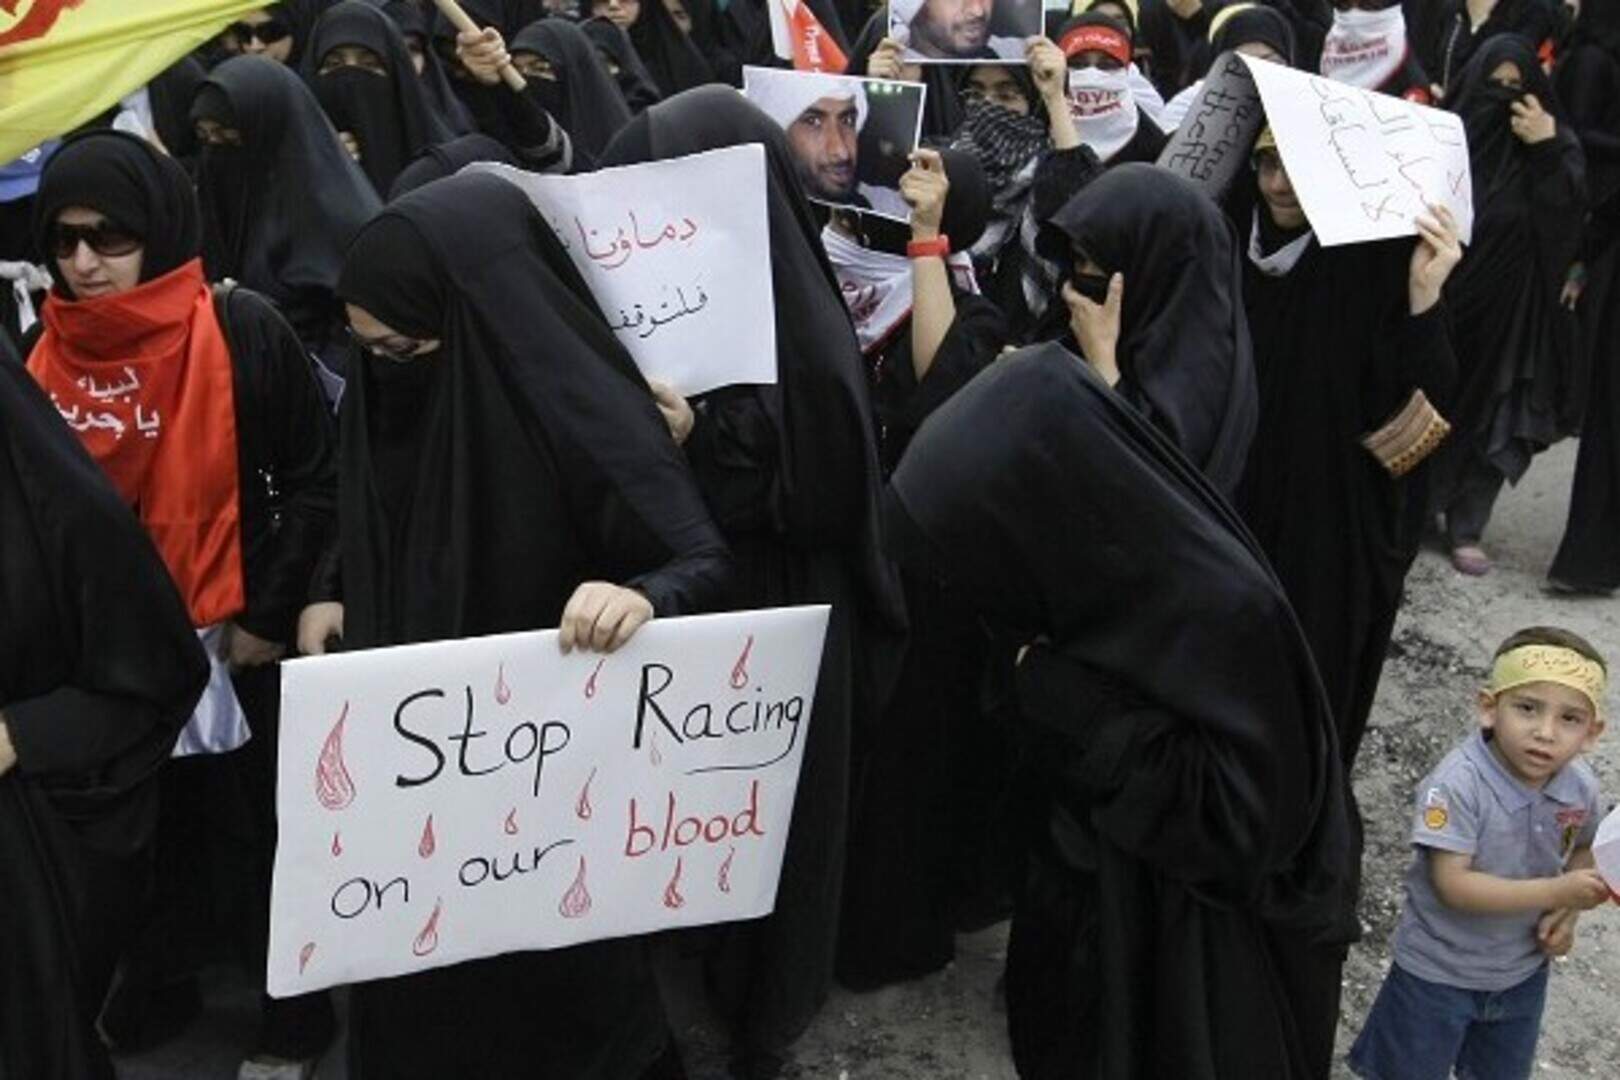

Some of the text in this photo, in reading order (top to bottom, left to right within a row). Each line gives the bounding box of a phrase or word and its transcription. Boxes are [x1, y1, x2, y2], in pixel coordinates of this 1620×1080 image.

[1168, 87, 1238, 168] theft
[76, 365, 141, 403] لبيك
[134, 403, 161, 438] يا
[393, 662, 804, 797] Stop Racing
[330, 778, 765, 920] on our blood
